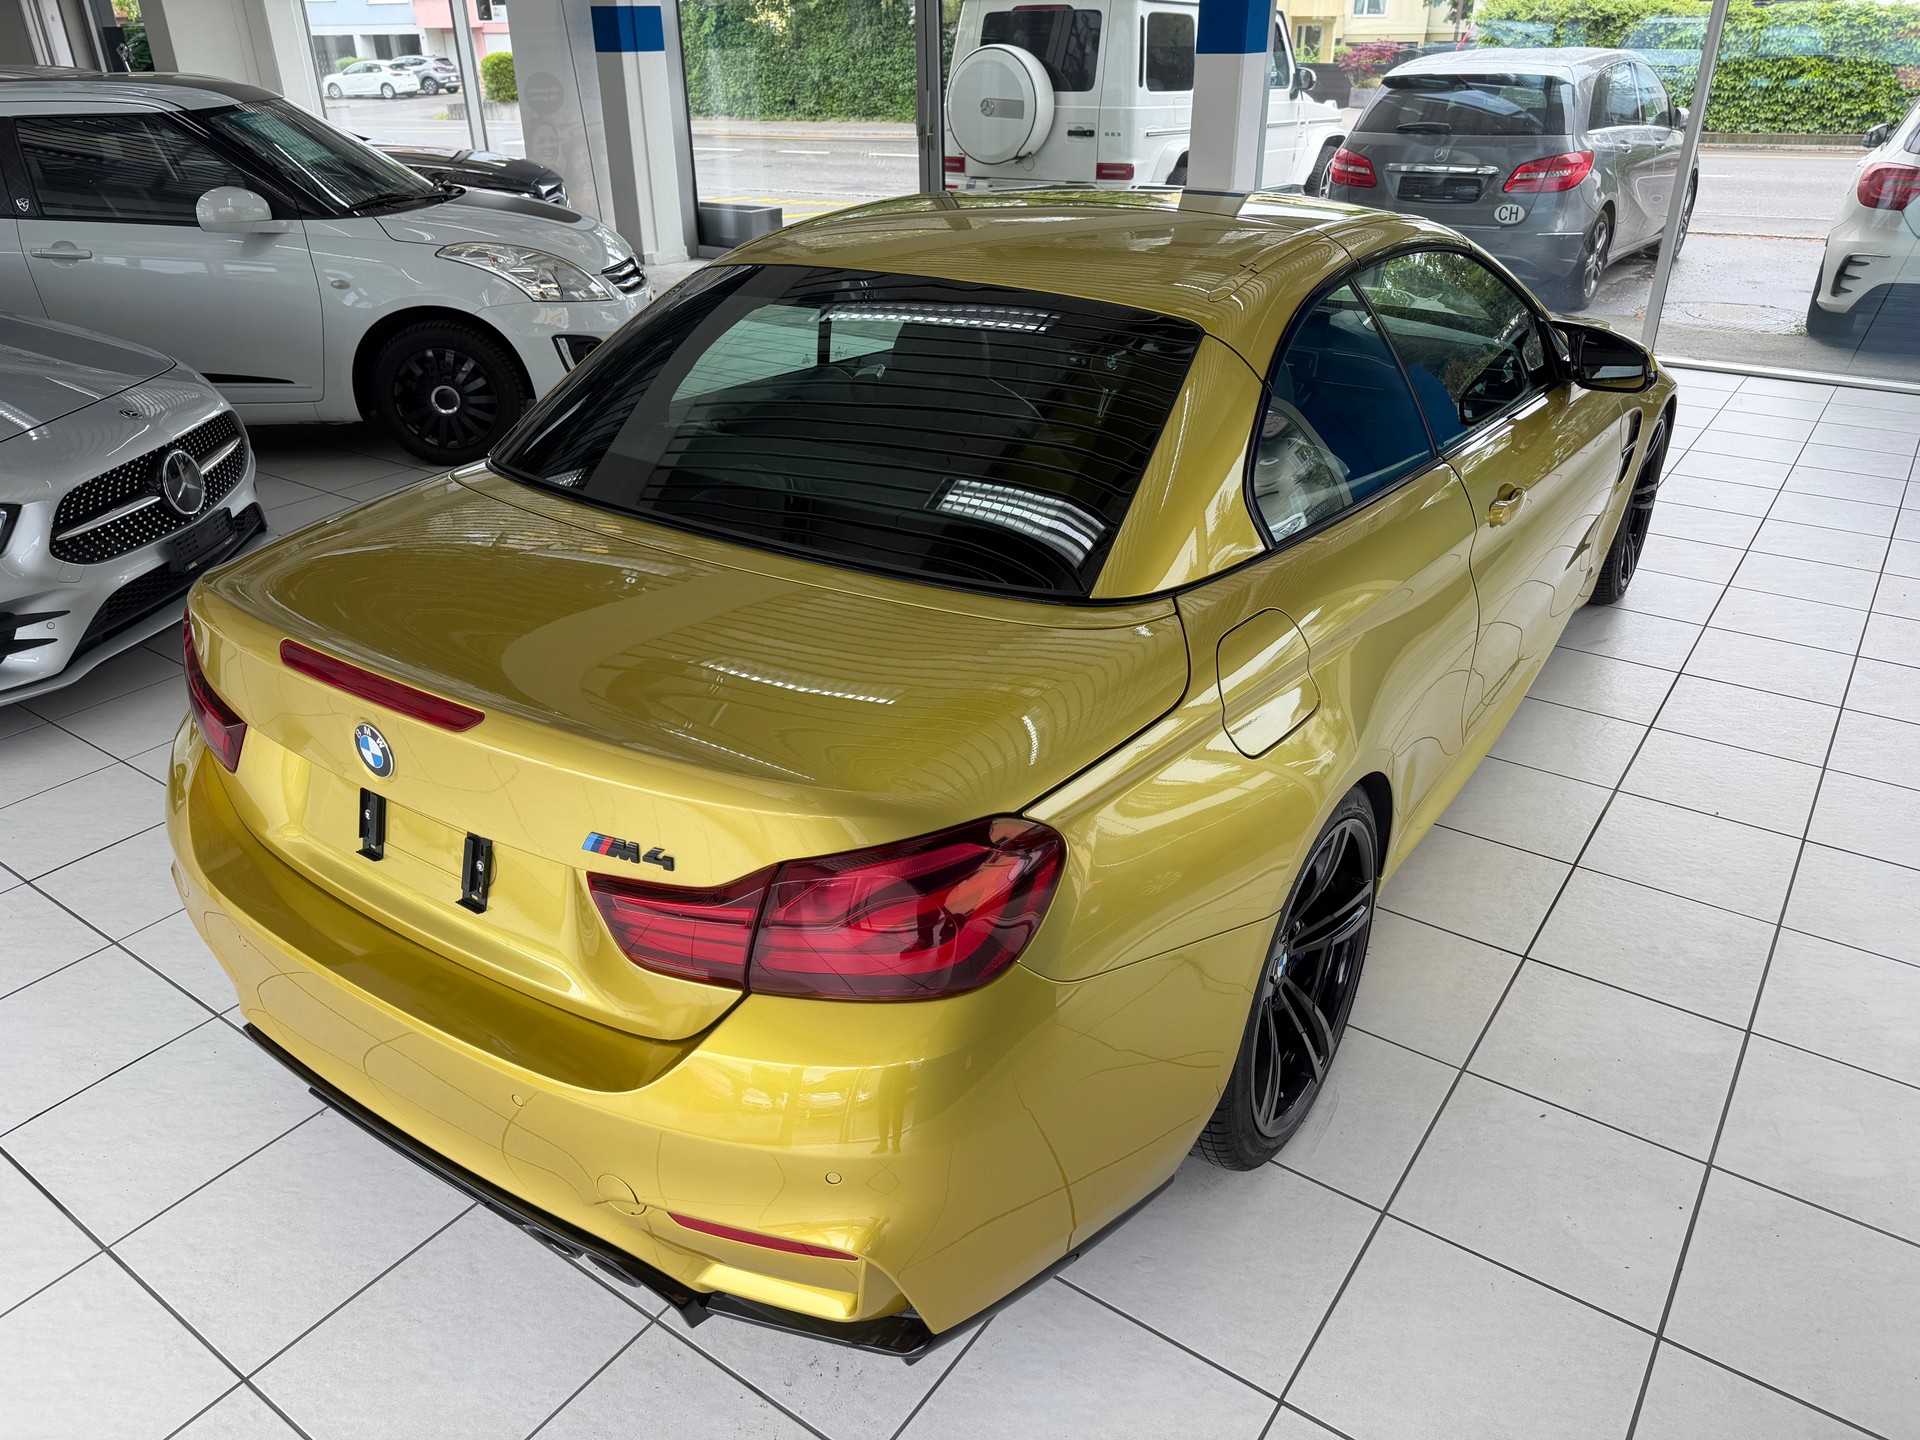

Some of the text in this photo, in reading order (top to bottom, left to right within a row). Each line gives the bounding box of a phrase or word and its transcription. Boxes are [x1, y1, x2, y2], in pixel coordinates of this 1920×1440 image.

[1498, 206, 1519, 221] CH
[355, 725, 386, 748] BMW
[605, 837, 674, 872] M4
